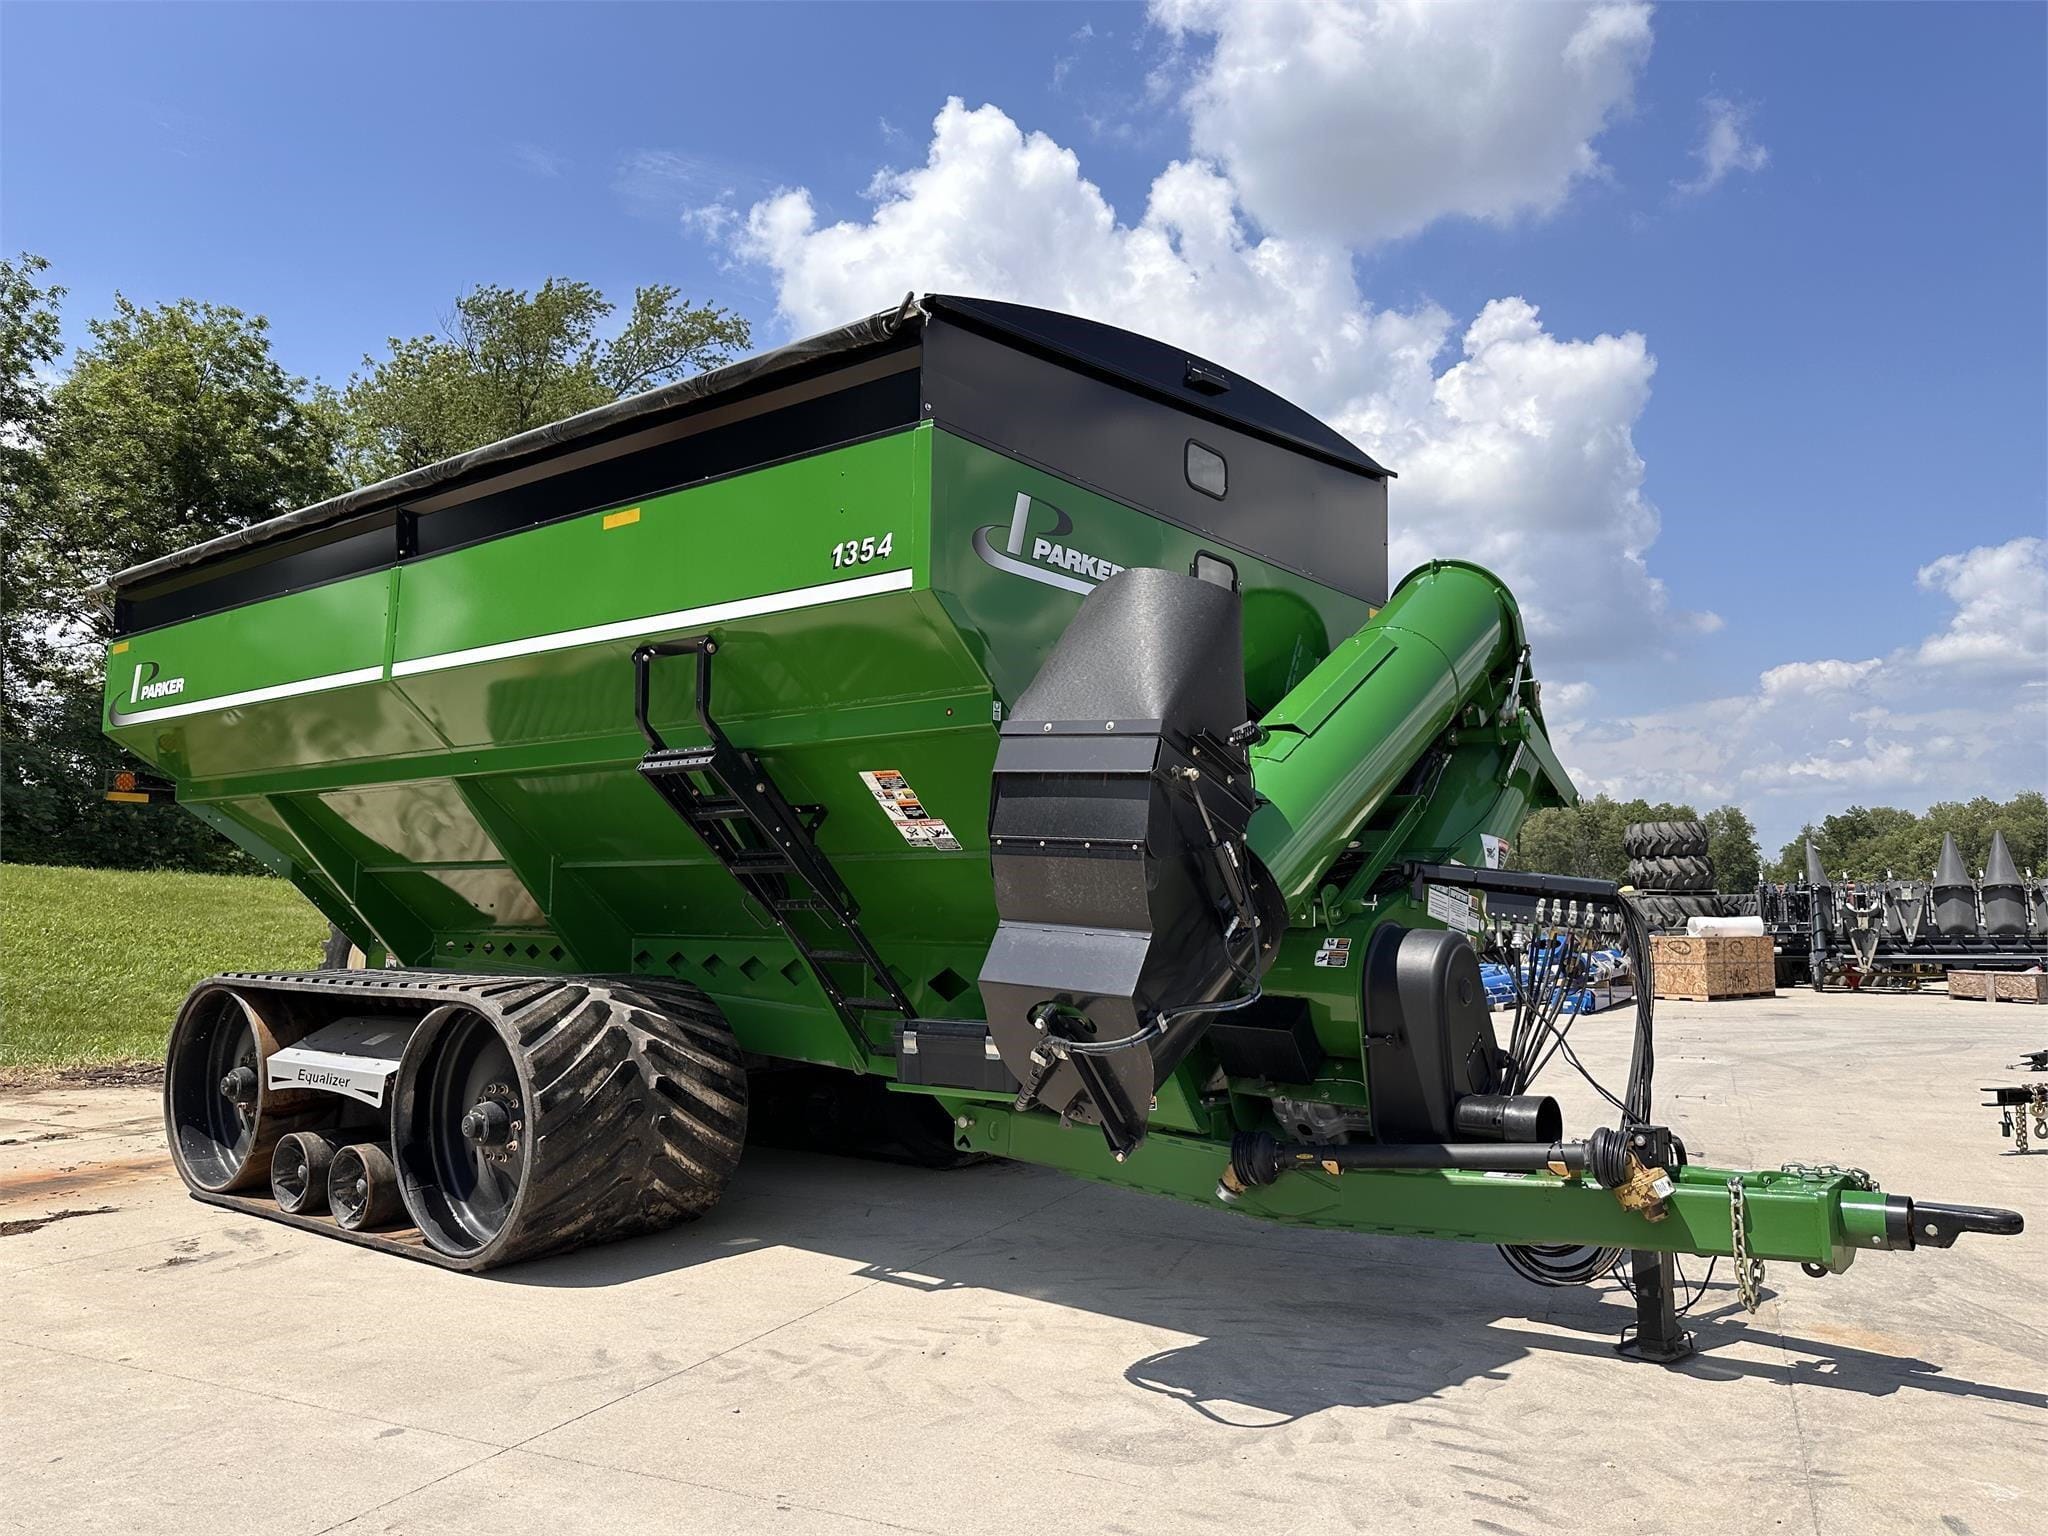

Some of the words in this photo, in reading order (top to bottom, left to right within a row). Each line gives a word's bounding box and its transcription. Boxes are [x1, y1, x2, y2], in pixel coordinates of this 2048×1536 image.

[832, 532, 894, 570] 1354
[140, 677, 185, 701] PARKER
[297, 1068, 351, 1088] Equalizer
